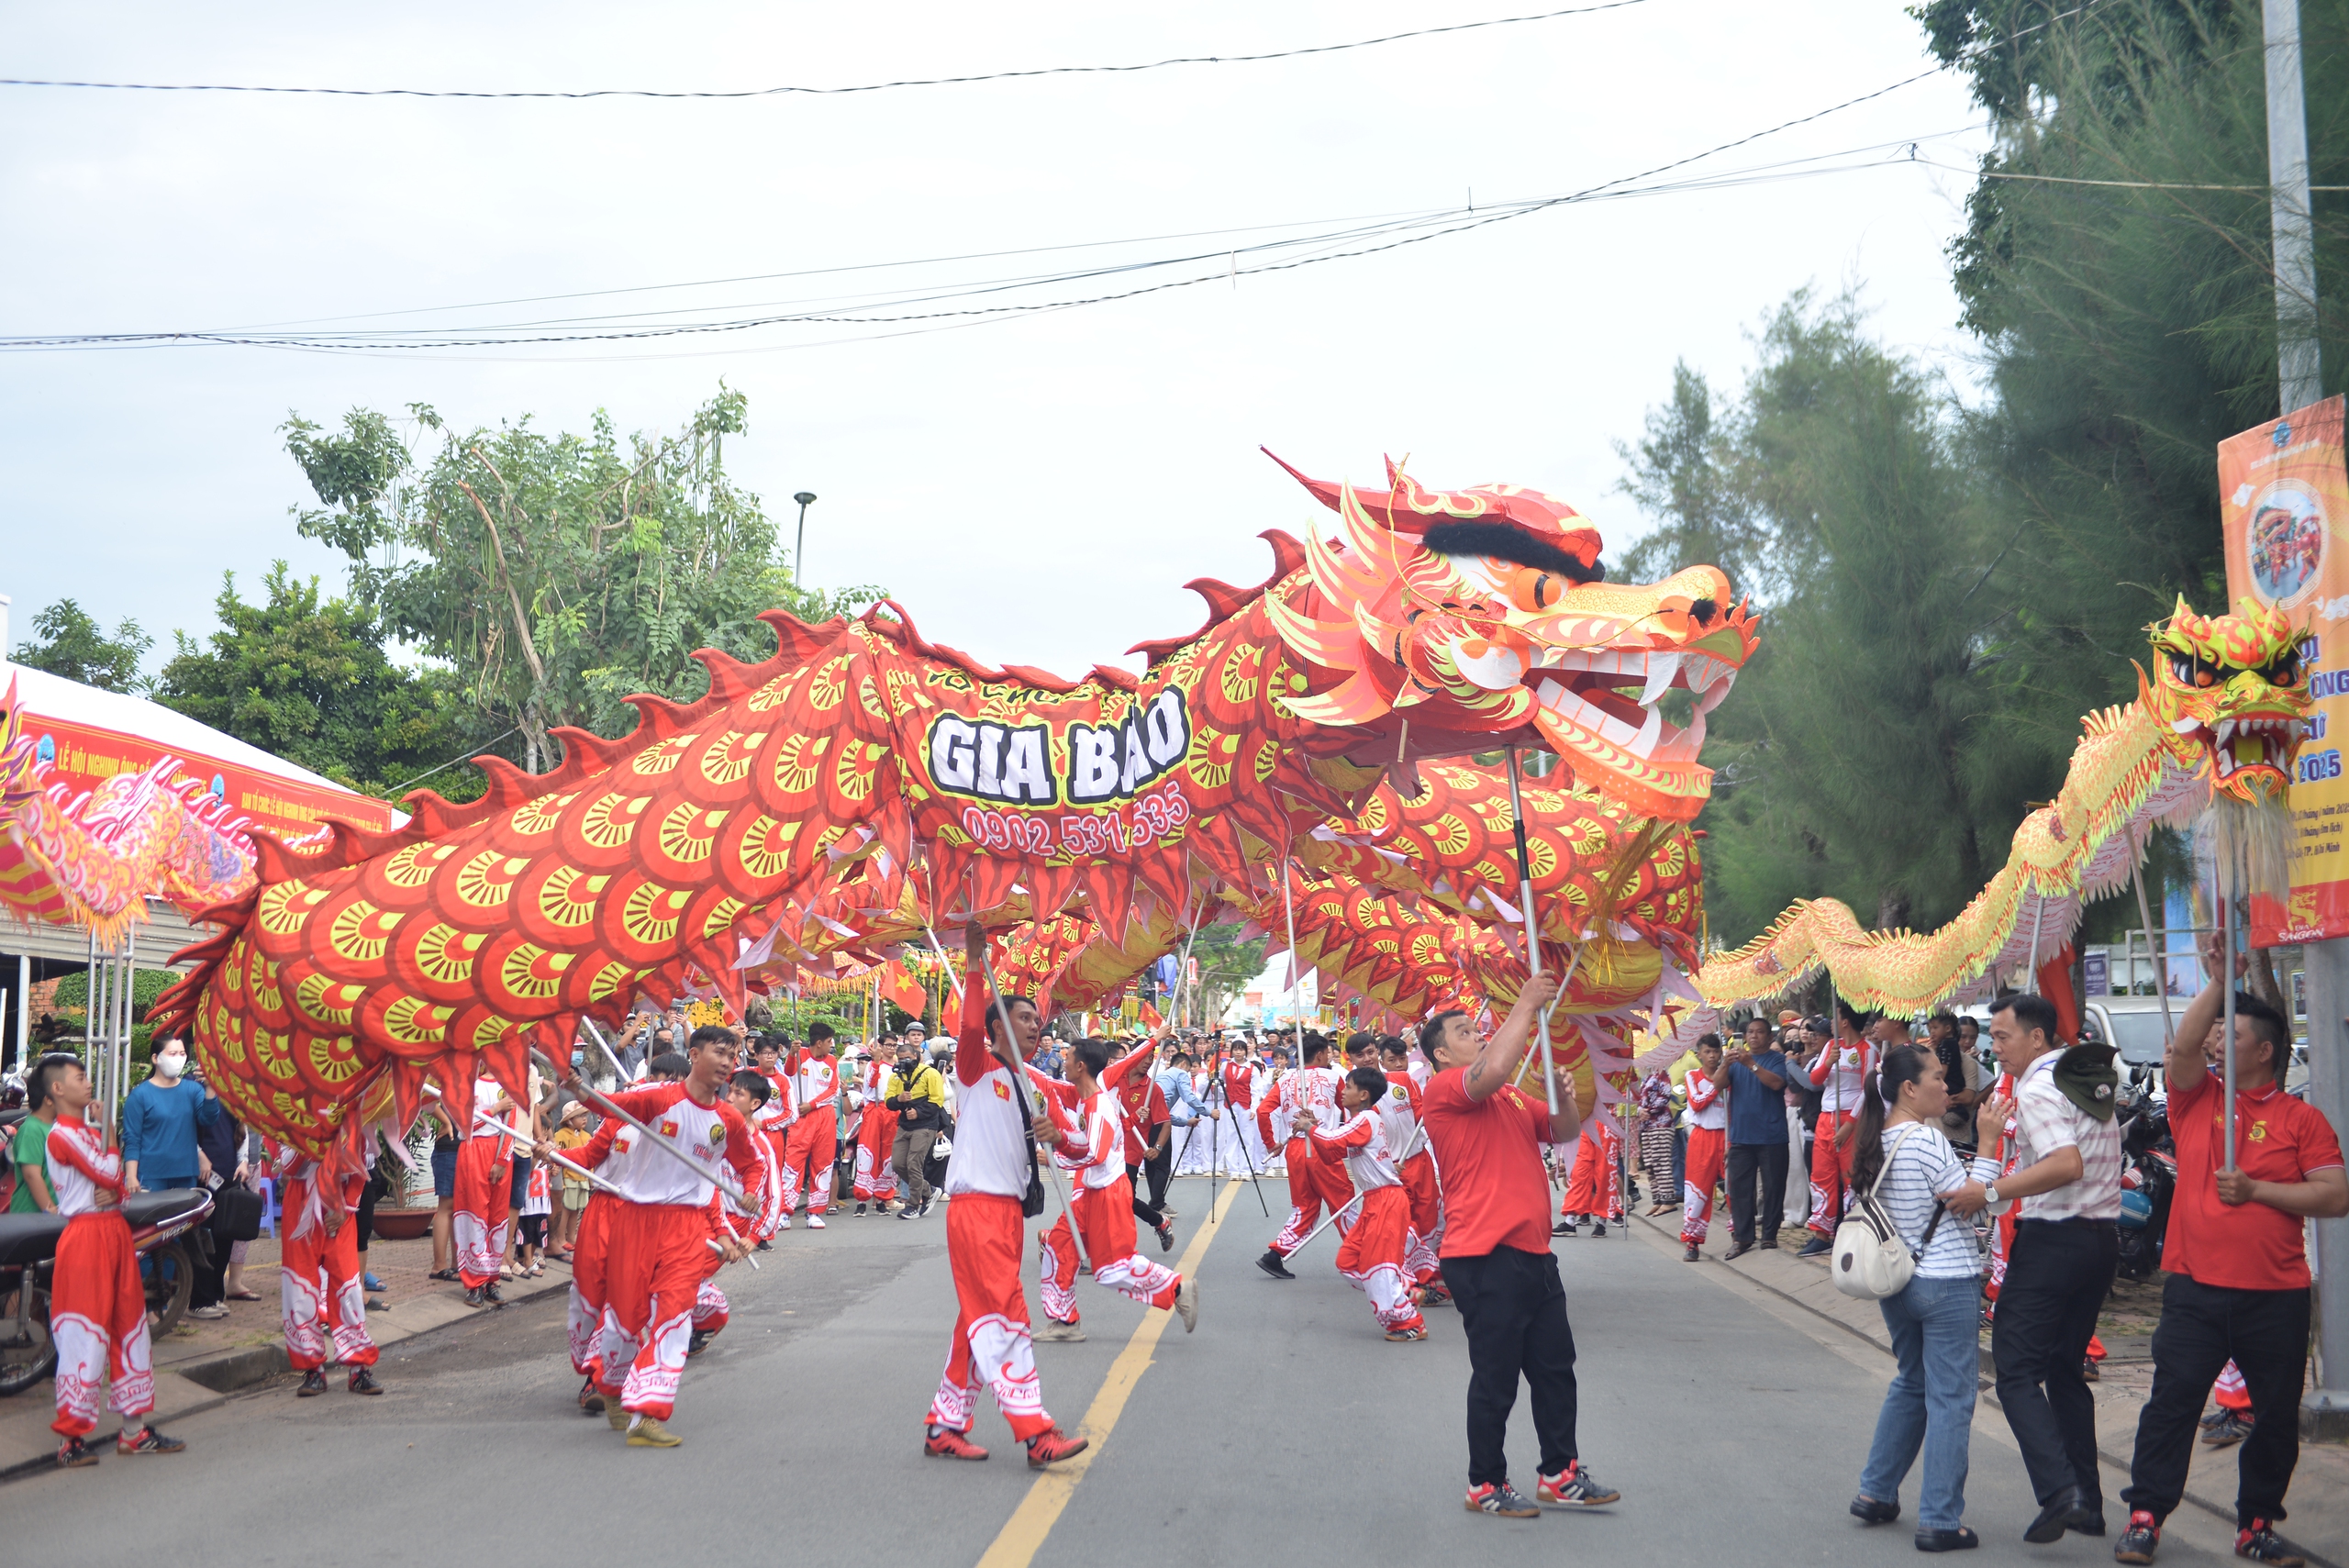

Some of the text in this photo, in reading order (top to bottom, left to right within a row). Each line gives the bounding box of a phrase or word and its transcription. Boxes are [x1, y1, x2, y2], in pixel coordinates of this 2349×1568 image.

[58, 740, 70, 771] LỄ
[70, 747, 86, 778] HỘI
[86, 753, 120, 779] NGHINH
[928, 713, 1057, 806] GIA
[2299, 751, 2341, 784] 2025
[963, 806, 1056, 857] 0902
[1061, 810, 1127, 855] 531
